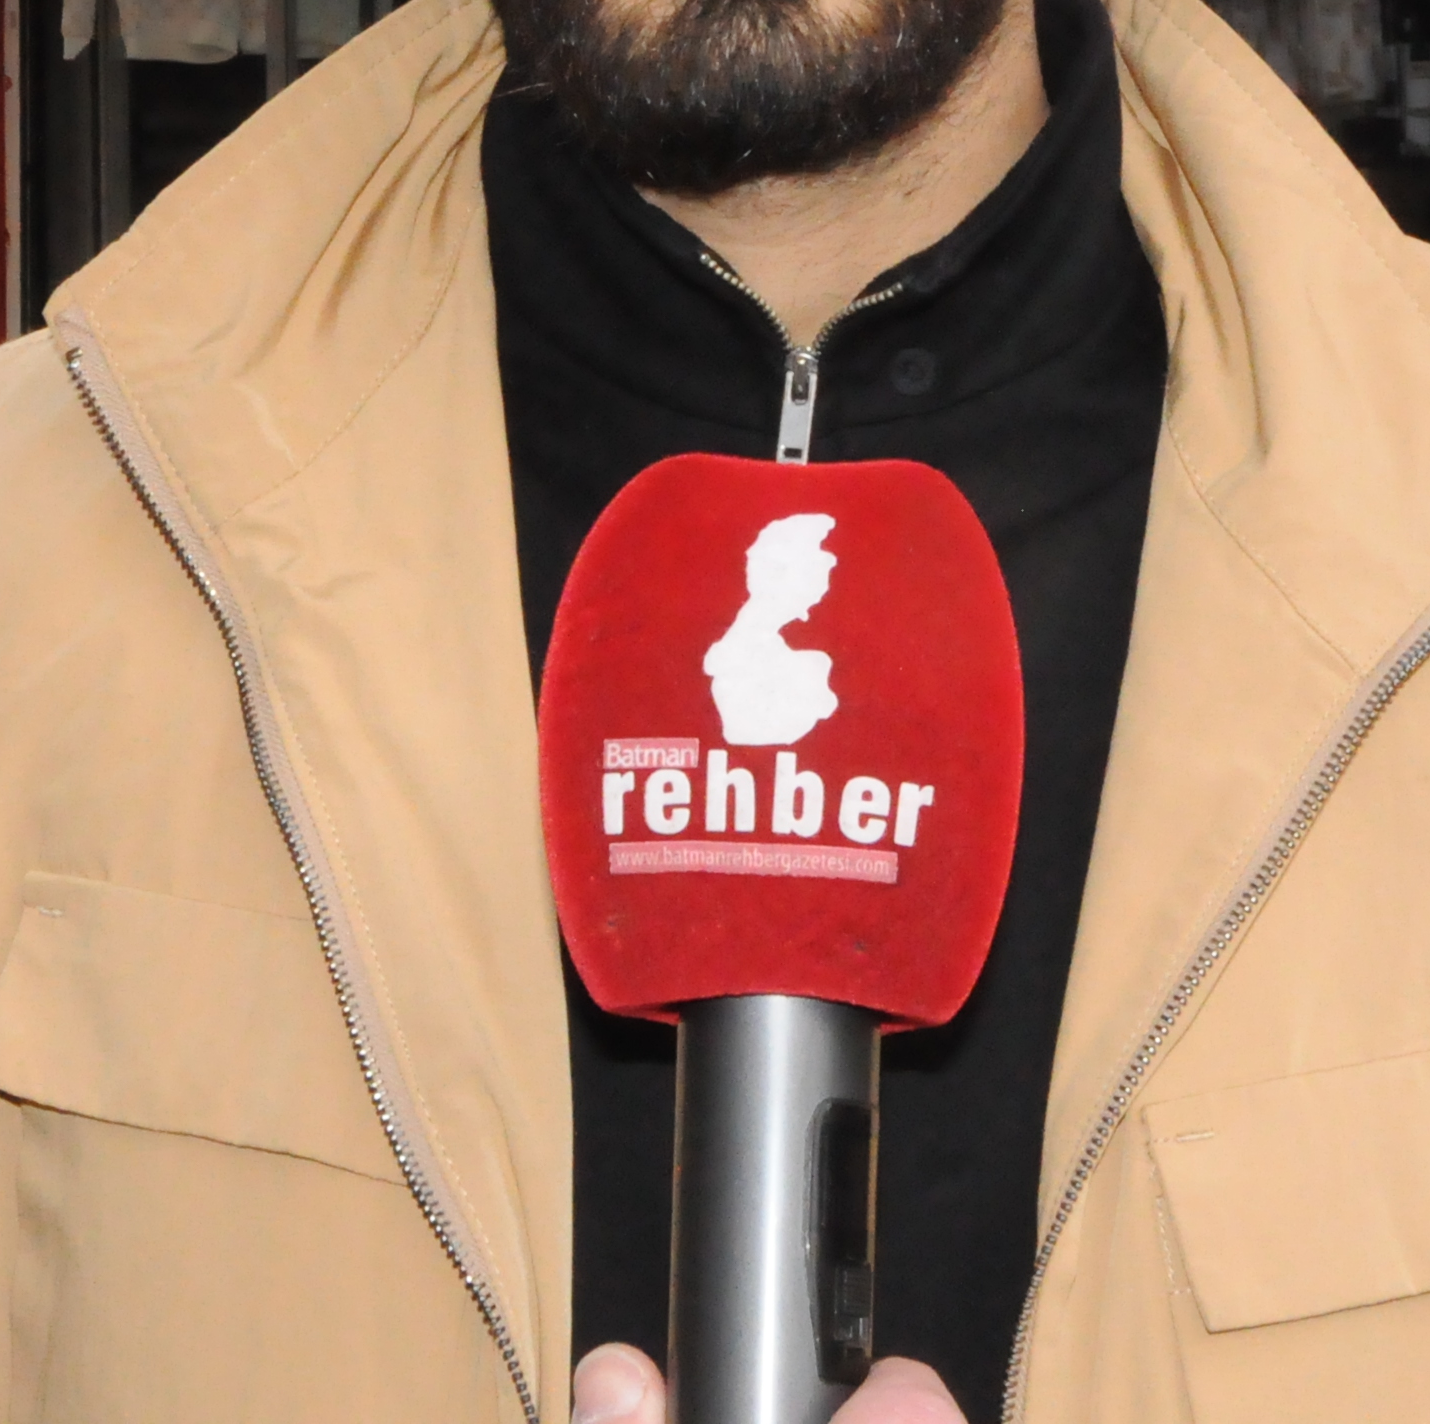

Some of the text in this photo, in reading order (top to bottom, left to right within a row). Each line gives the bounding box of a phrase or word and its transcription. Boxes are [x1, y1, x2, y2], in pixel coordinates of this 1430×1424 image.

[606, 742, 696, 768] Batman
[603, 749, 935, 847] rehber
[616, 847, 891, 875] www.batmanrehbergazetesi.com
